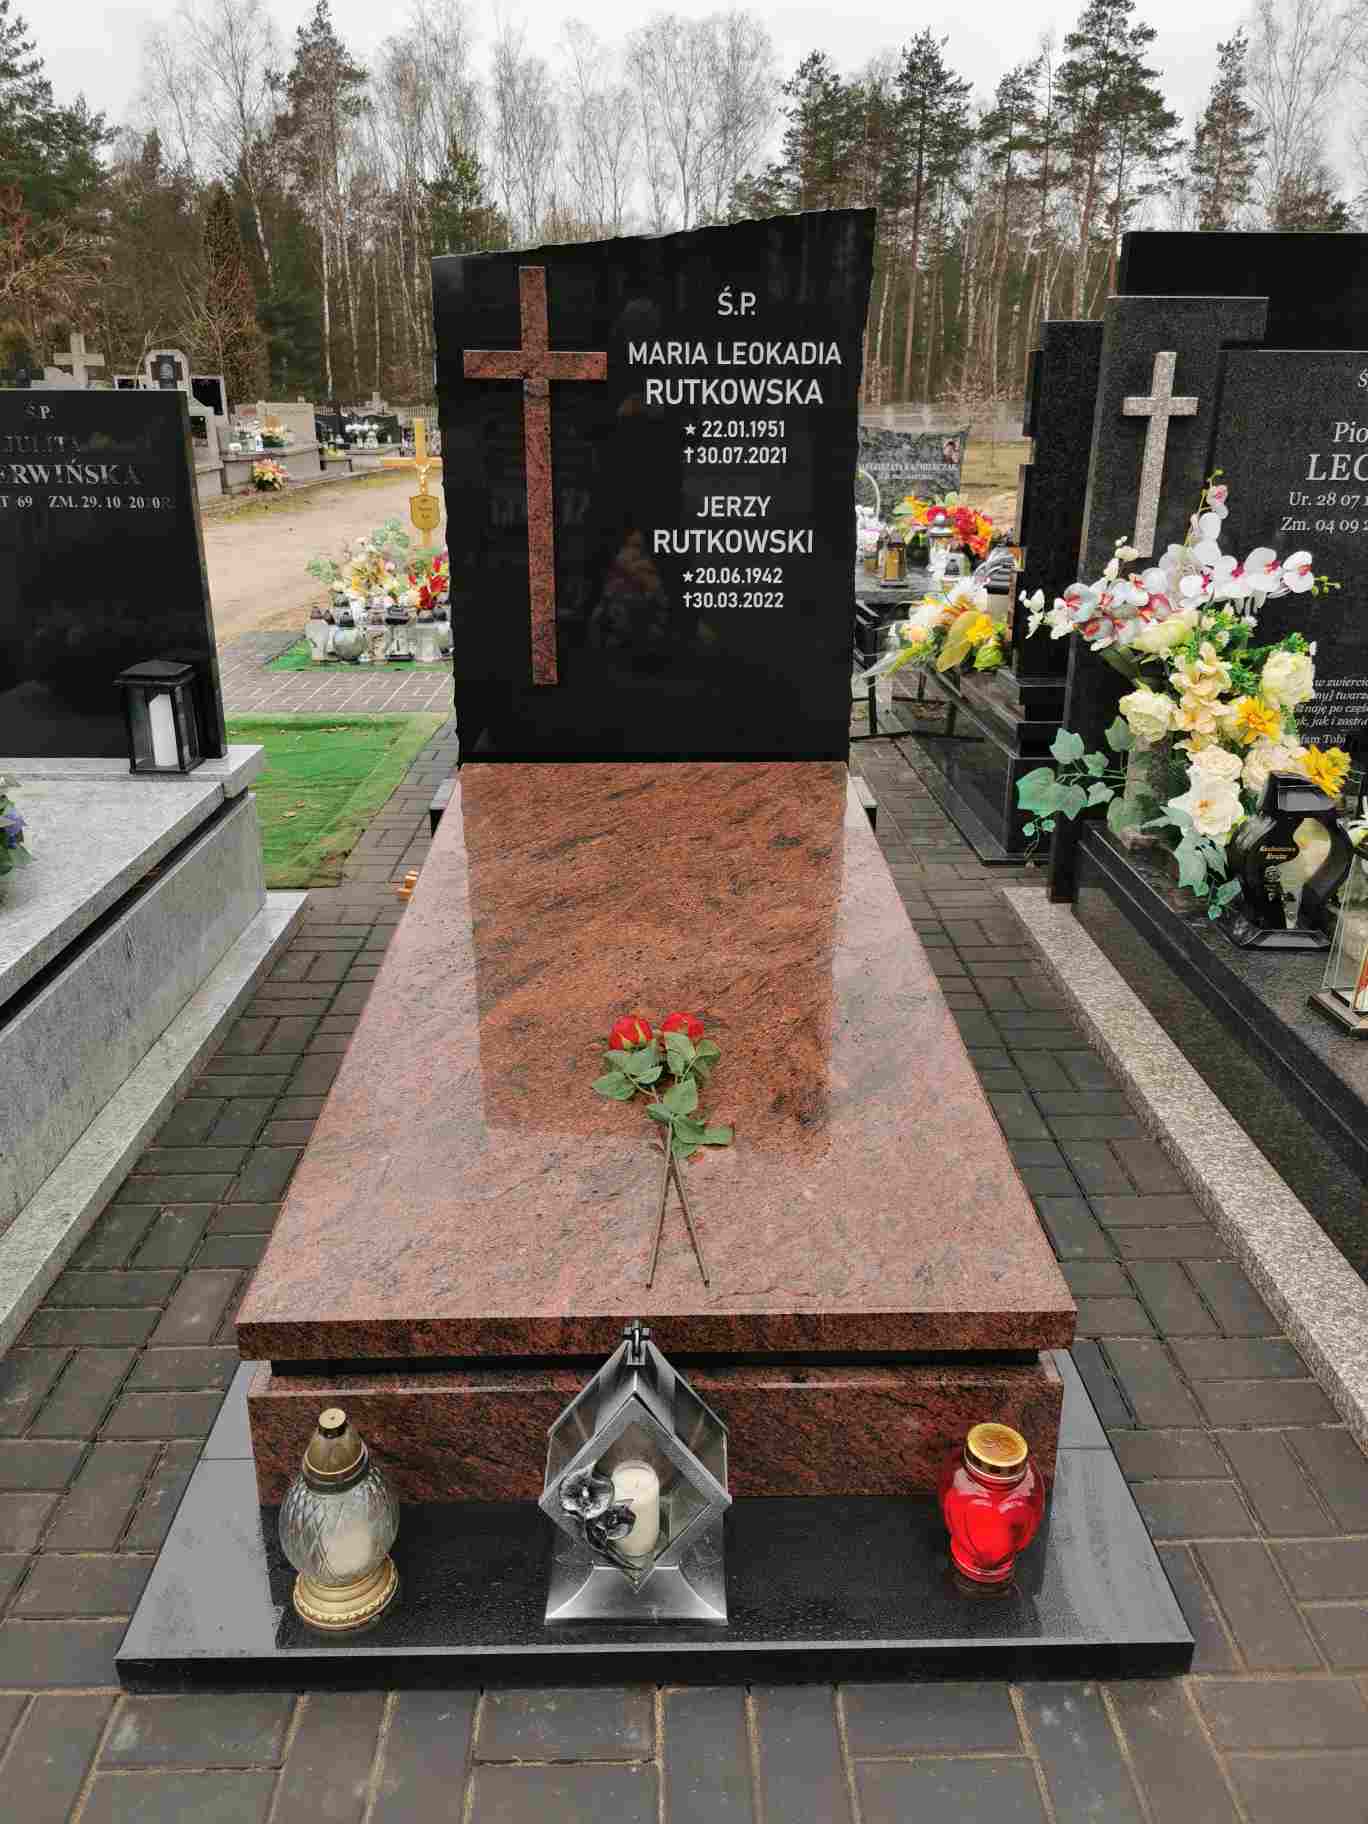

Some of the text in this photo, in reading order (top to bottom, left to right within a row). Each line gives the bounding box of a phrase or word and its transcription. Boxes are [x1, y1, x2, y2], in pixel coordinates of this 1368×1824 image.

[718, 286, 757, 316] Ś.P.
[628, 342, 842, 366] MARIA LEOKADIA
[645, 379, 824, 405] RUTKOWSKA
[701, 420, 785, 439] 22.01.1951
[696, 446, 787, 465] 30.07.2021
[696, 496, 772, 518] JERZY
[1315, 491, 1337, 506] 28
[1340, 495, 1360, 509] 07
[653, 529, 814, 554] RUTKOWSKI
[695, 567, 783, 585] 20.06.1942
[692, 592, 785, 609] 30.03.2022
